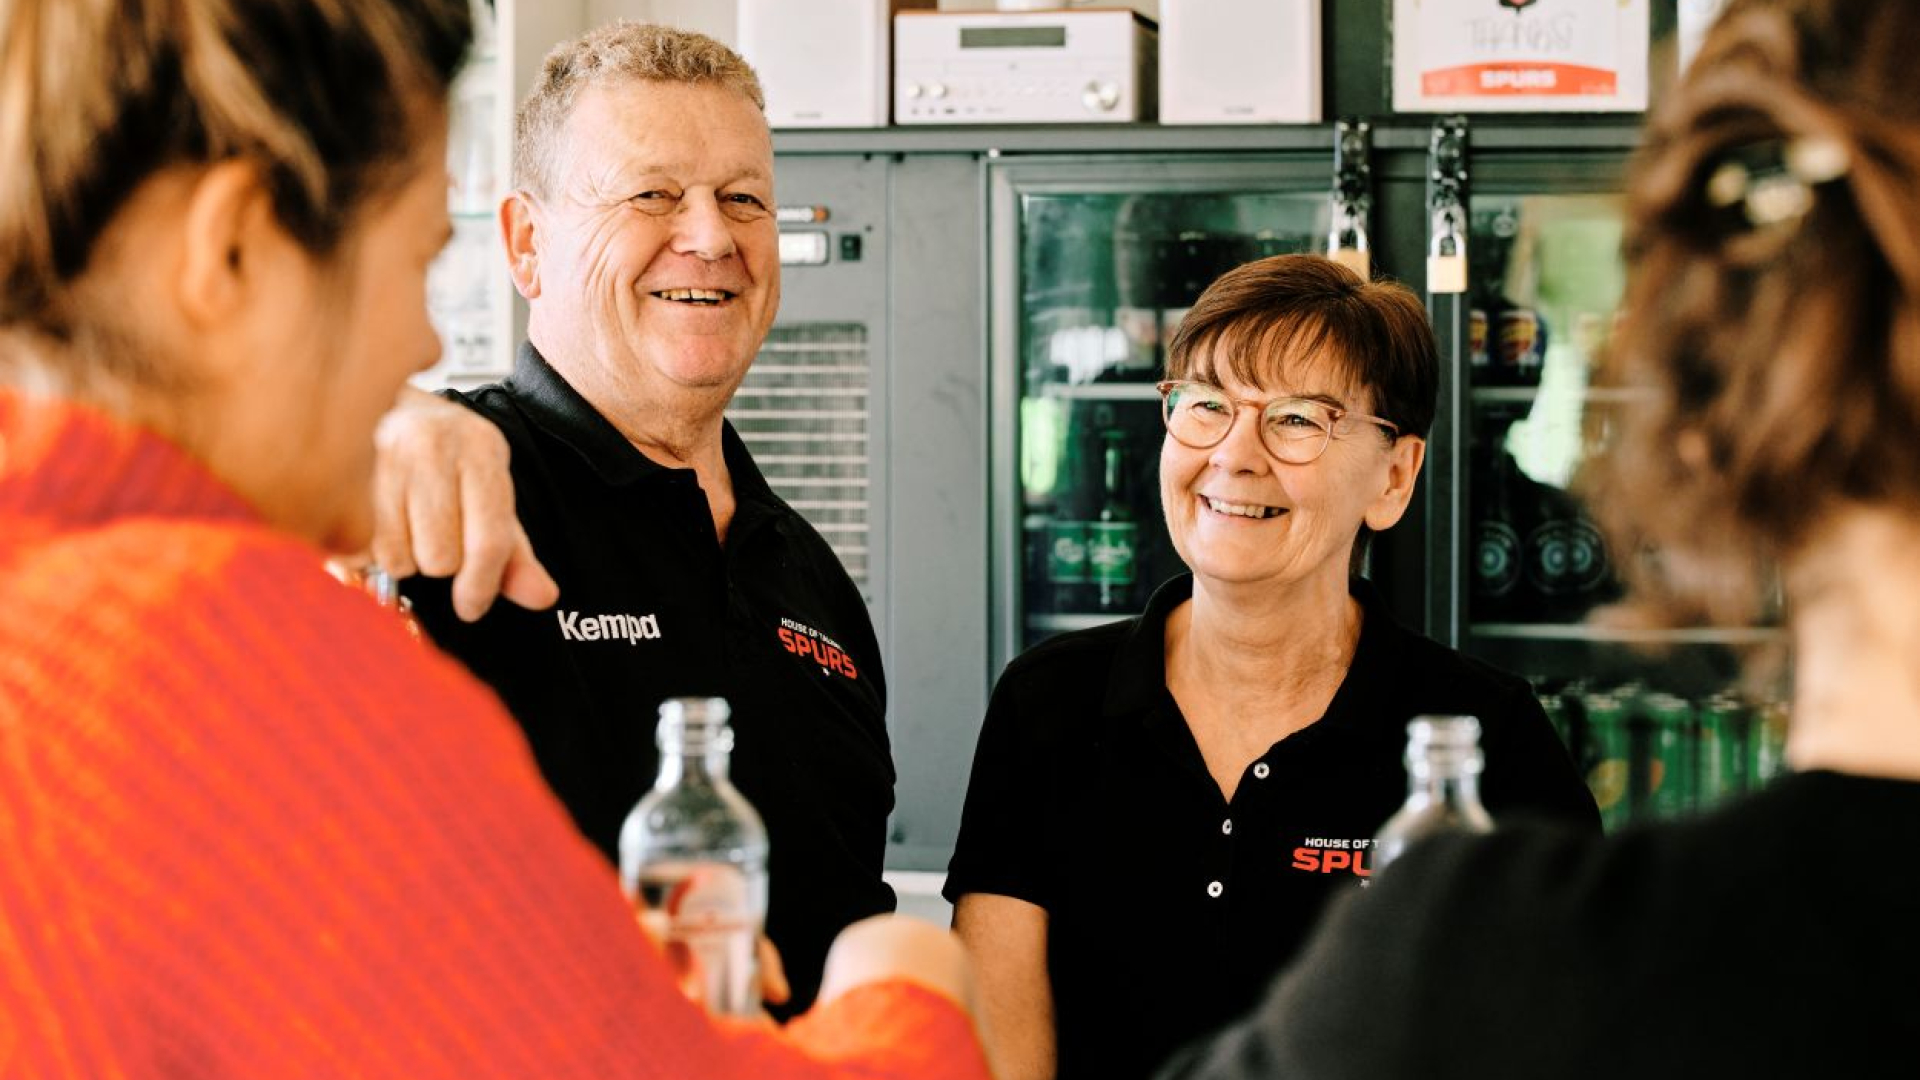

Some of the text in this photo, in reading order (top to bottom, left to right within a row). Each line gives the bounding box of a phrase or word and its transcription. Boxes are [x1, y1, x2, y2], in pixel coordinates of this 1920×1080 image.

[557, 610, 661, 645] Kempa
[777, 627, 858, 680] SPURS
[1304, 837, 1350, 849] HOUSE
[1352, 839, 1370, 849] OF
[1292, 847, 1378, 877] SPU
